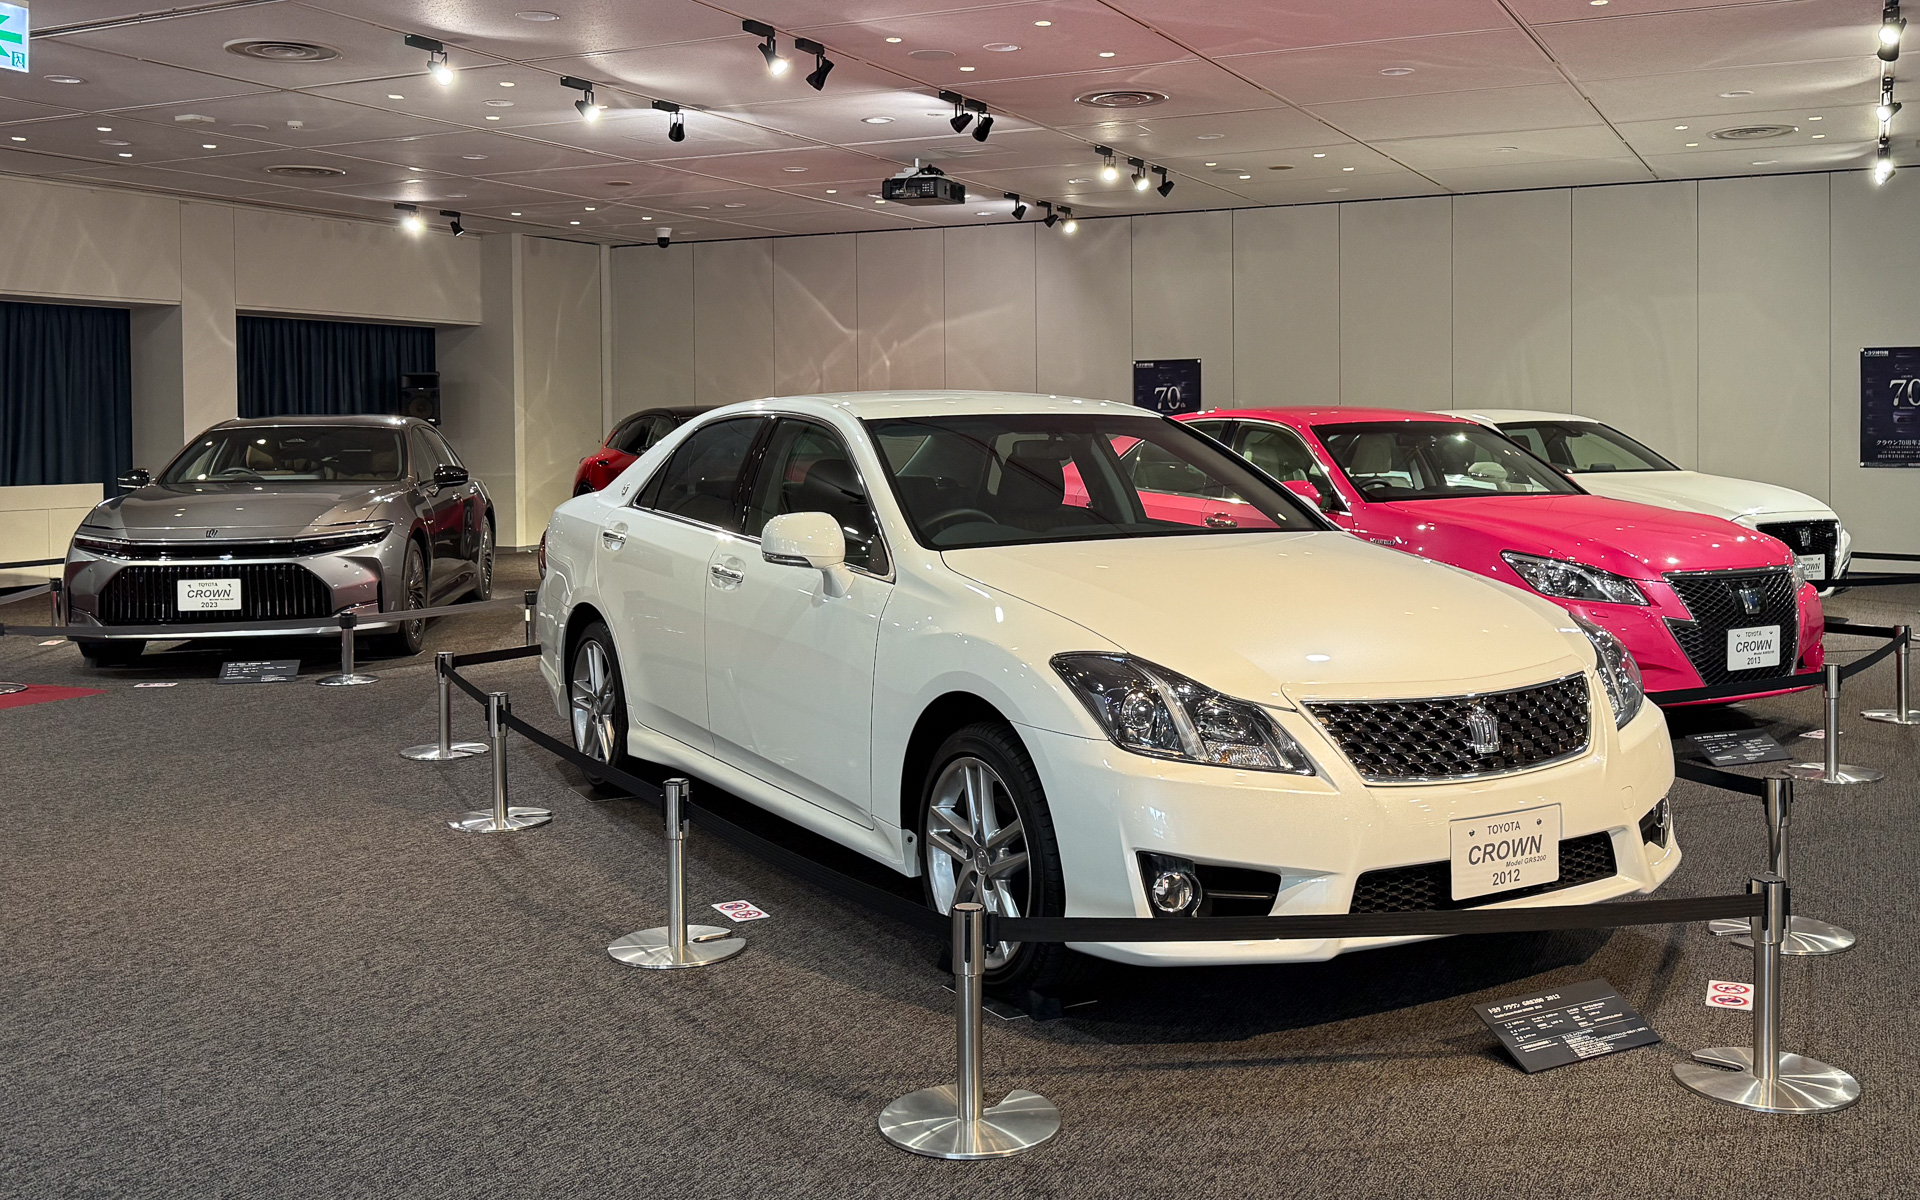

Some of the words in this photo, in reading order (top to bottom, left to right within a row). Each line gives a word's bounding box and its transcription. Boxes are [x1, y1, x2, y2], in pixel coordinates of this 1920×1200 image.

[1889, 378, 1920, 407] 70
[1802, 562, 1821, 571] ROWN
[187, 589, 231, 599] CROWN
[1745, 630, 1762, 638] TOYOTA
[1735, 639, 1773, 653] CROWN
[1747, 656, 1761, 665] 2013
[1487, 820, 1521, 835] TOYOTA
[1468, 833, 1543, 866] CROWN
[1505, 858, 1524, 868] Model
[1524, 854, 1547, 865] GRS200
[1492, 868, 1521, 886] 2012
